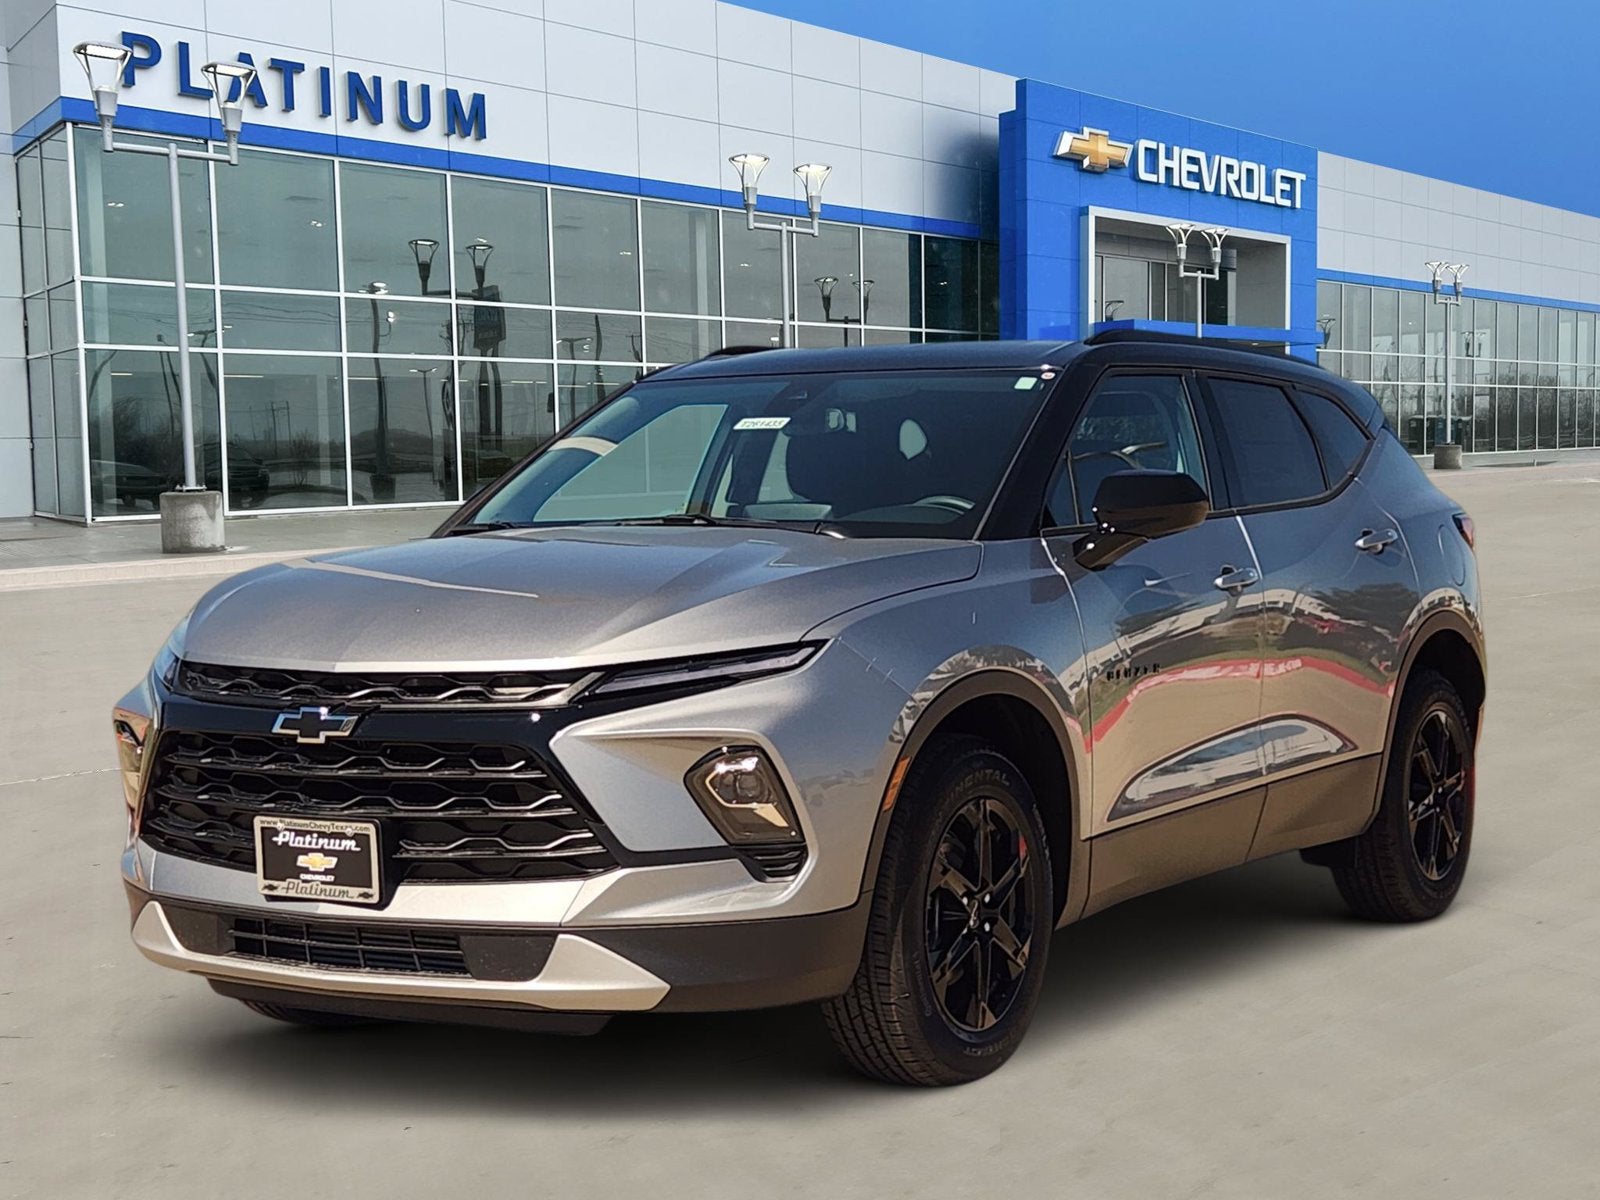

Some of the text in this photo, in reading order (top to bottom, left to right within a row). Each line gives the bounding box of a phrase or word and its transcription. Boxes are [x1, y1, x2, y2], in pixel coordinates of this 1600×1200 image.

[121, 31, 487, 140] PLATINUM
[1137, 139, 1306, 208] CHEVROLET
[272, 830, 361, 851] Platinum
[281, 880, 355, 899] Platinum
